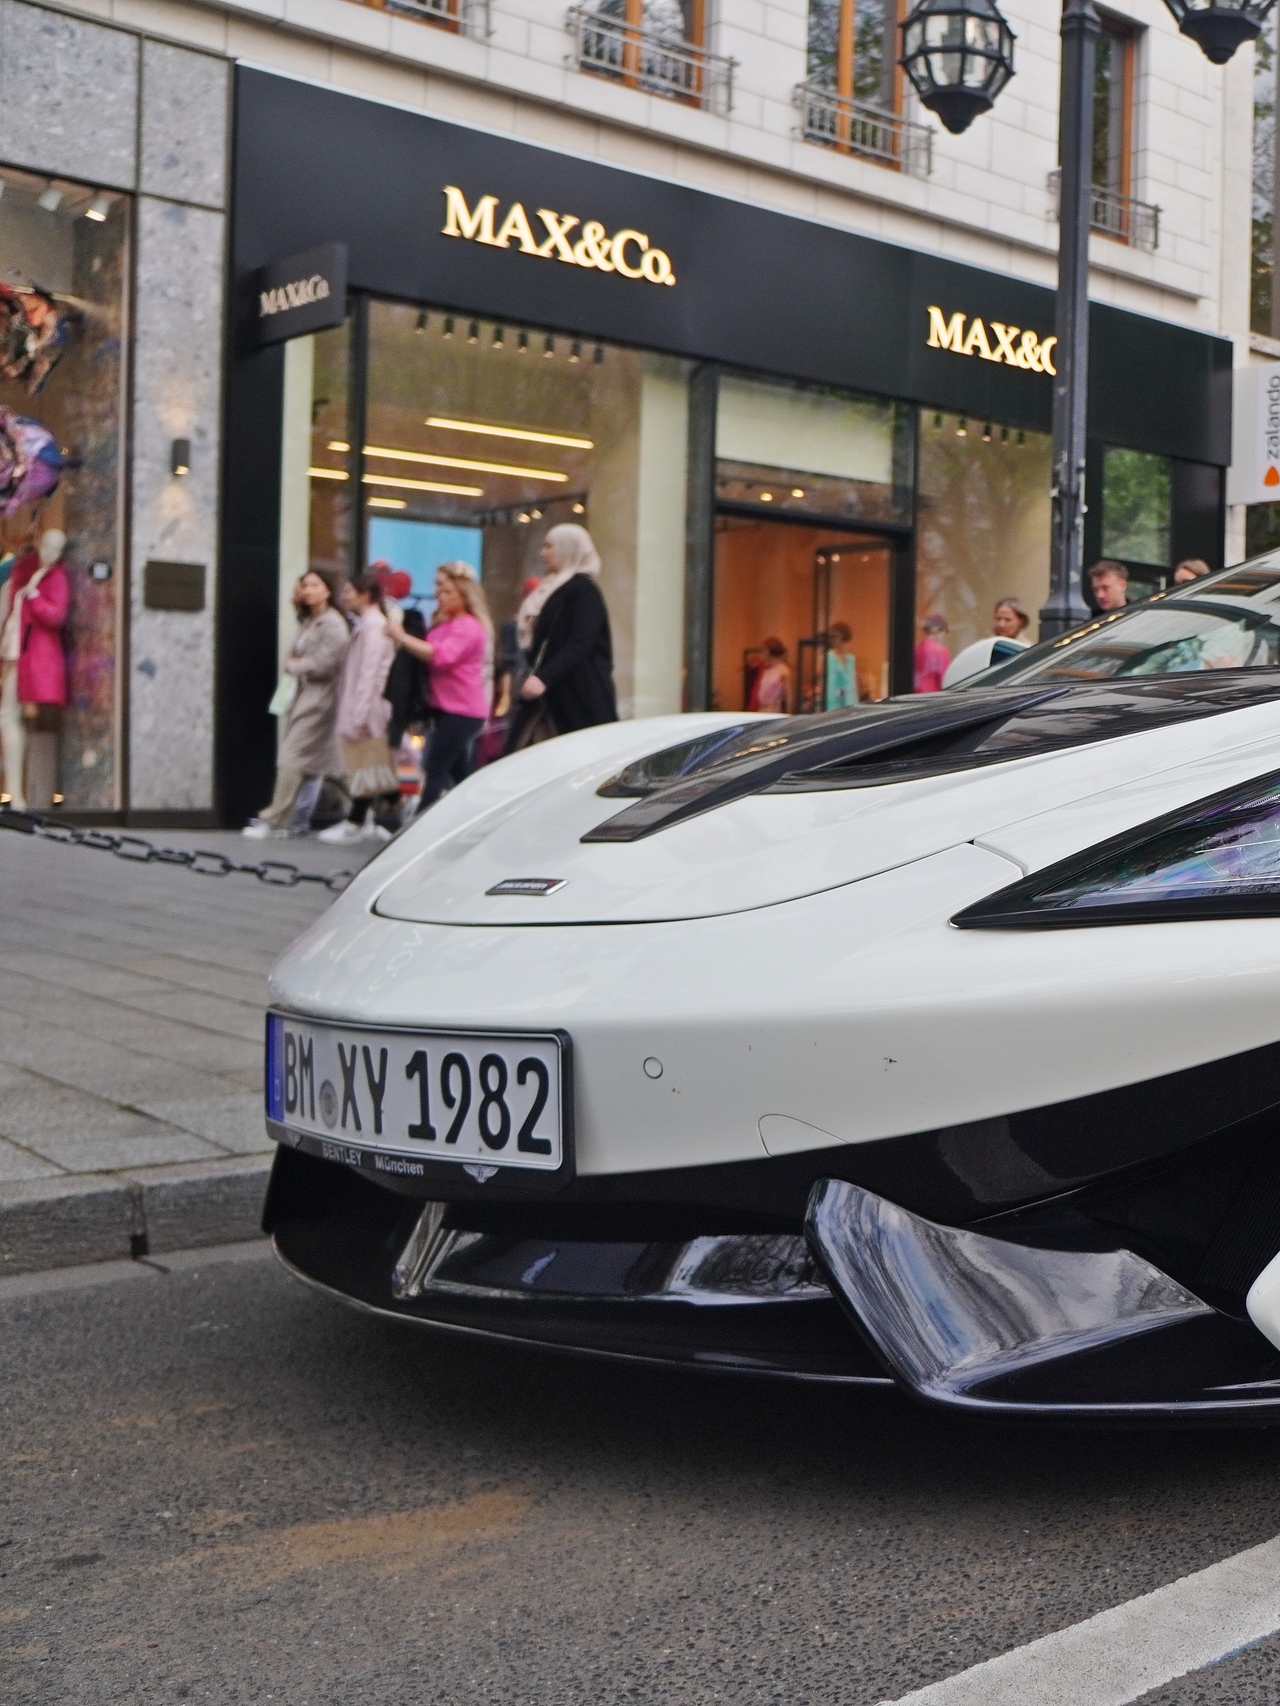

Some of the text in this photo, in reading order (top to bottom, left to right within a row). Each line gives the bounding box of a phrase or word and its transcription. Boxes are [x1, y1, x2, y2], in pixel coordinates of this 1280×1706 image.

[442, 185, 676, 286] MAX&Co.
[927, 305, 1058, 376] MAX&C
[284, 1031, 554, 1156] BM XY 1982
[321, 1142, 424, 1175] BENTLEY München
